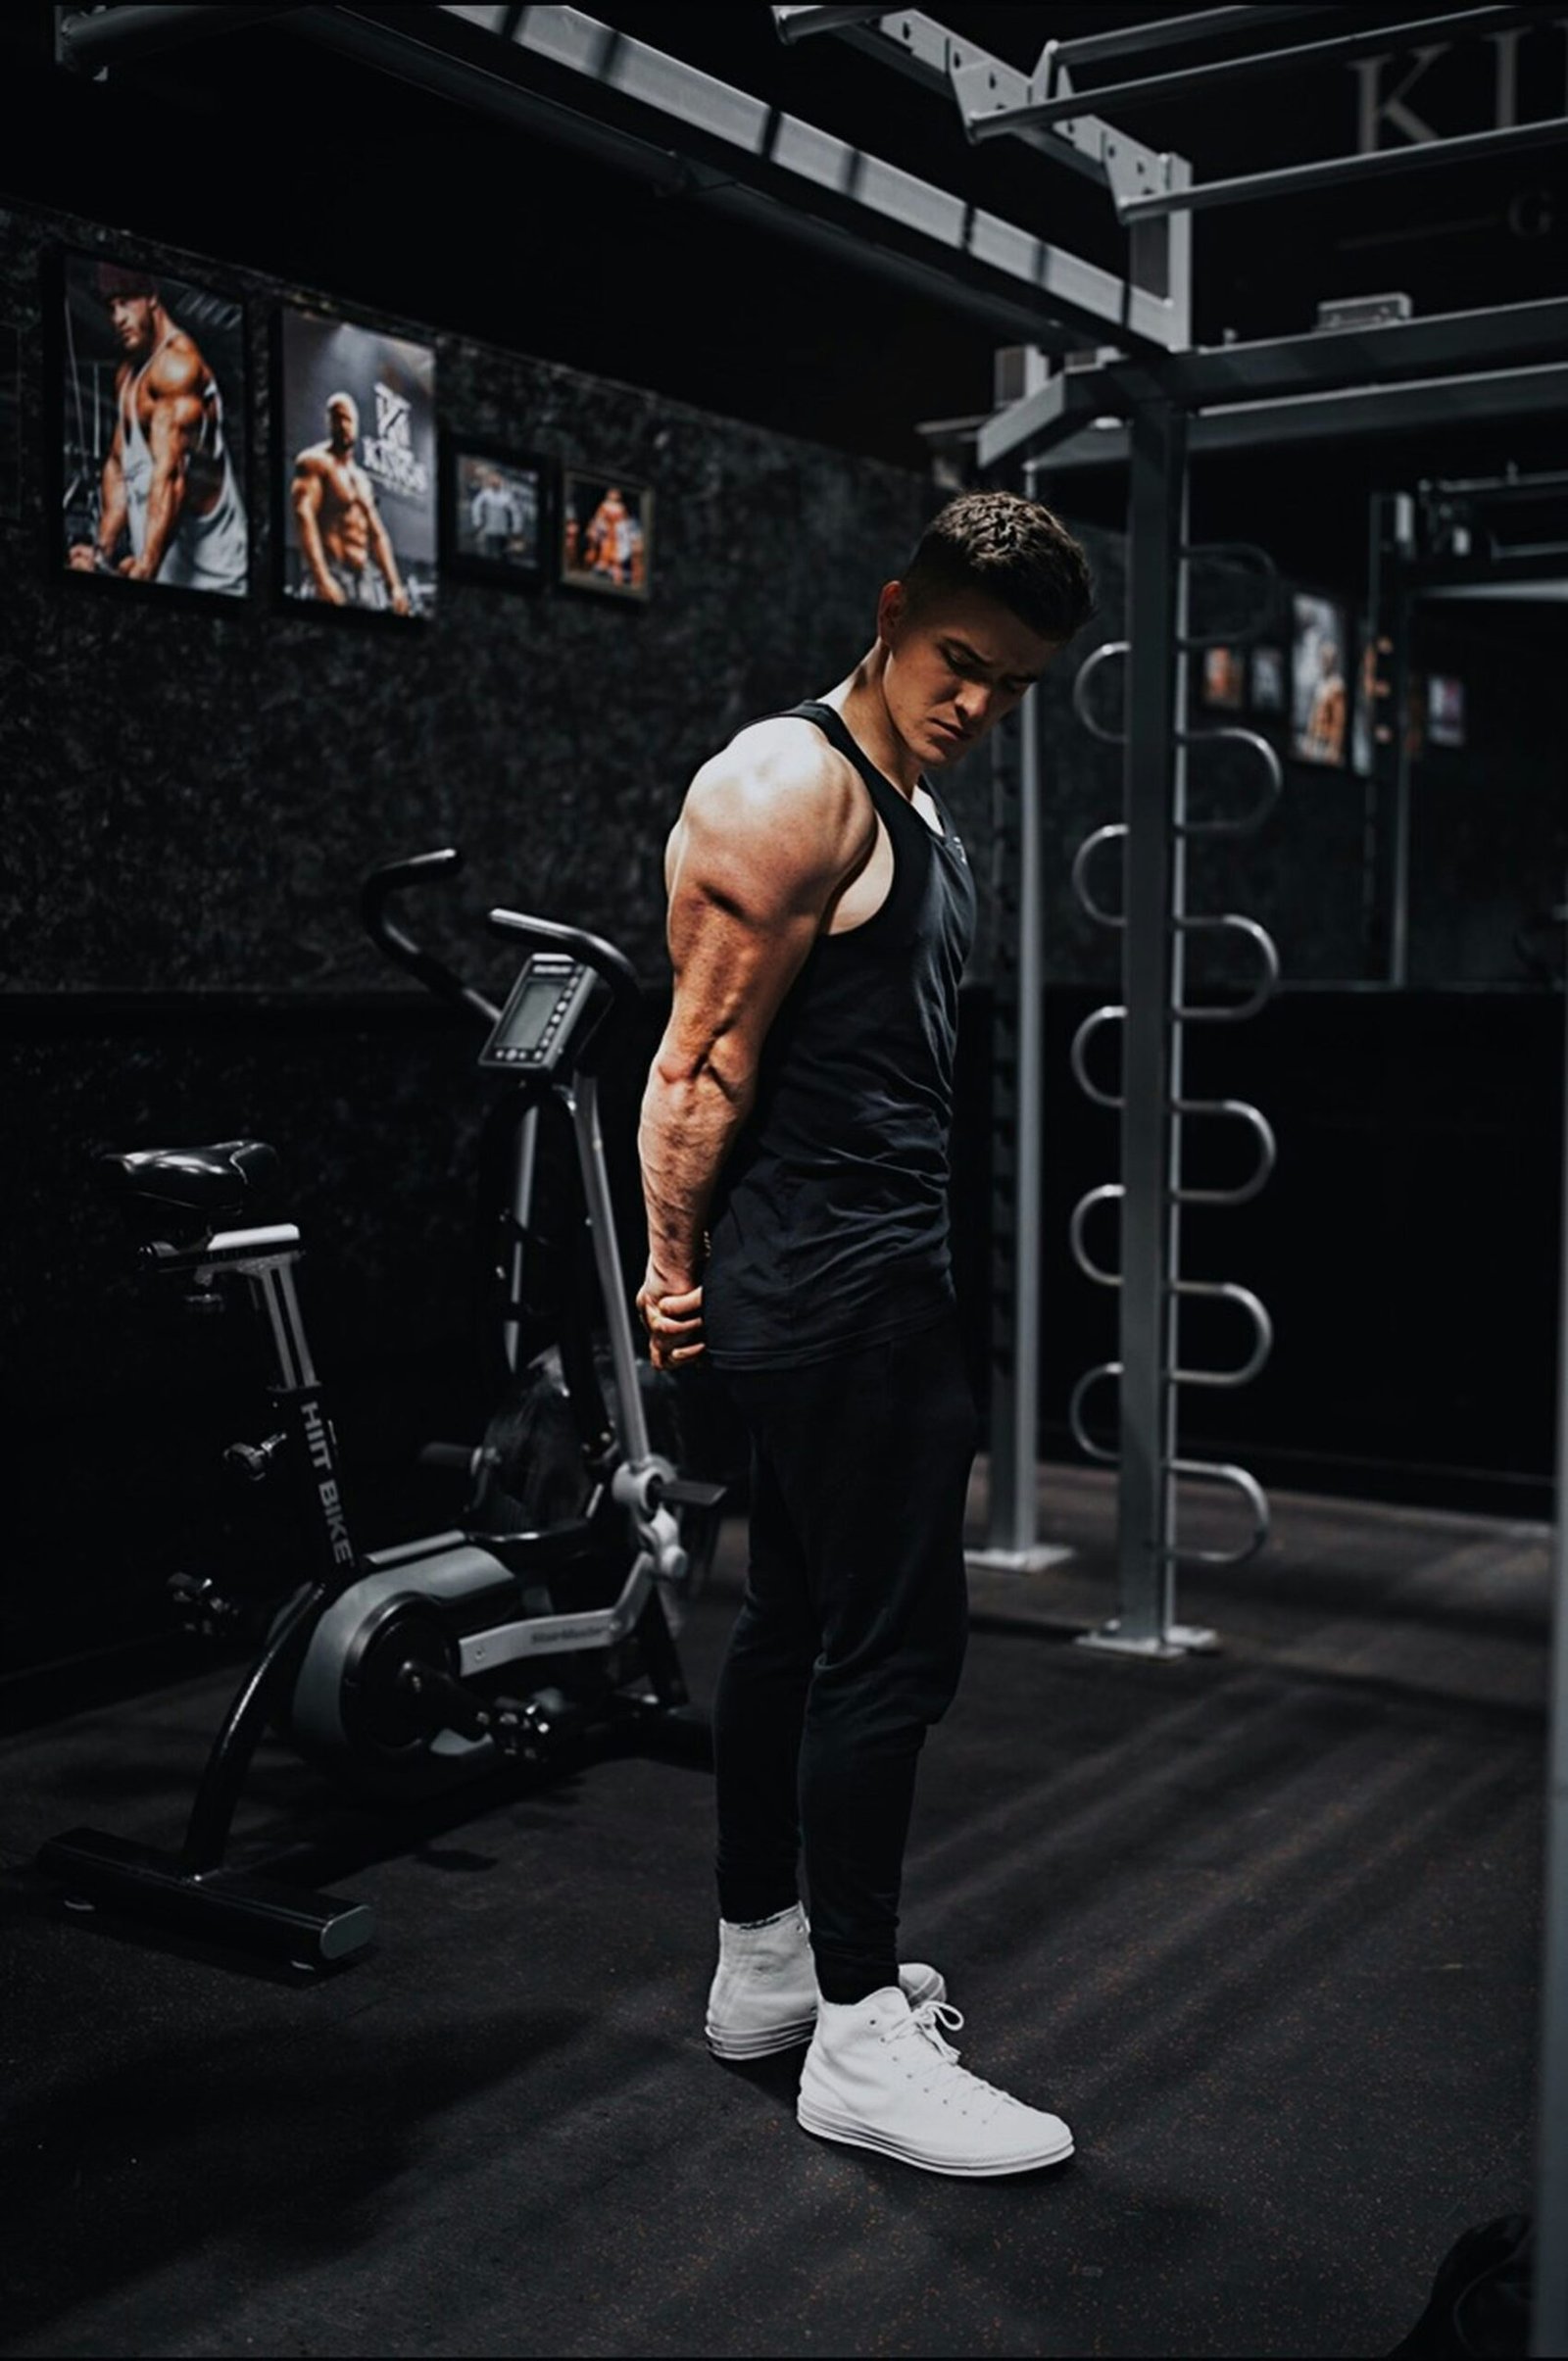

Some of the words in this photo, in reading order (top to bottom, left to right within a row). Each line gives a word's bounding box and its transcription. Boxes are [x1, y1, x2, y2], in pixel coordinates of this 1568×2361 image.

[1343, 17, 1568, 154] KI
[300, 1400, 333, 1471] HIIT
[318, 1478, 356, 1568] BIKE
